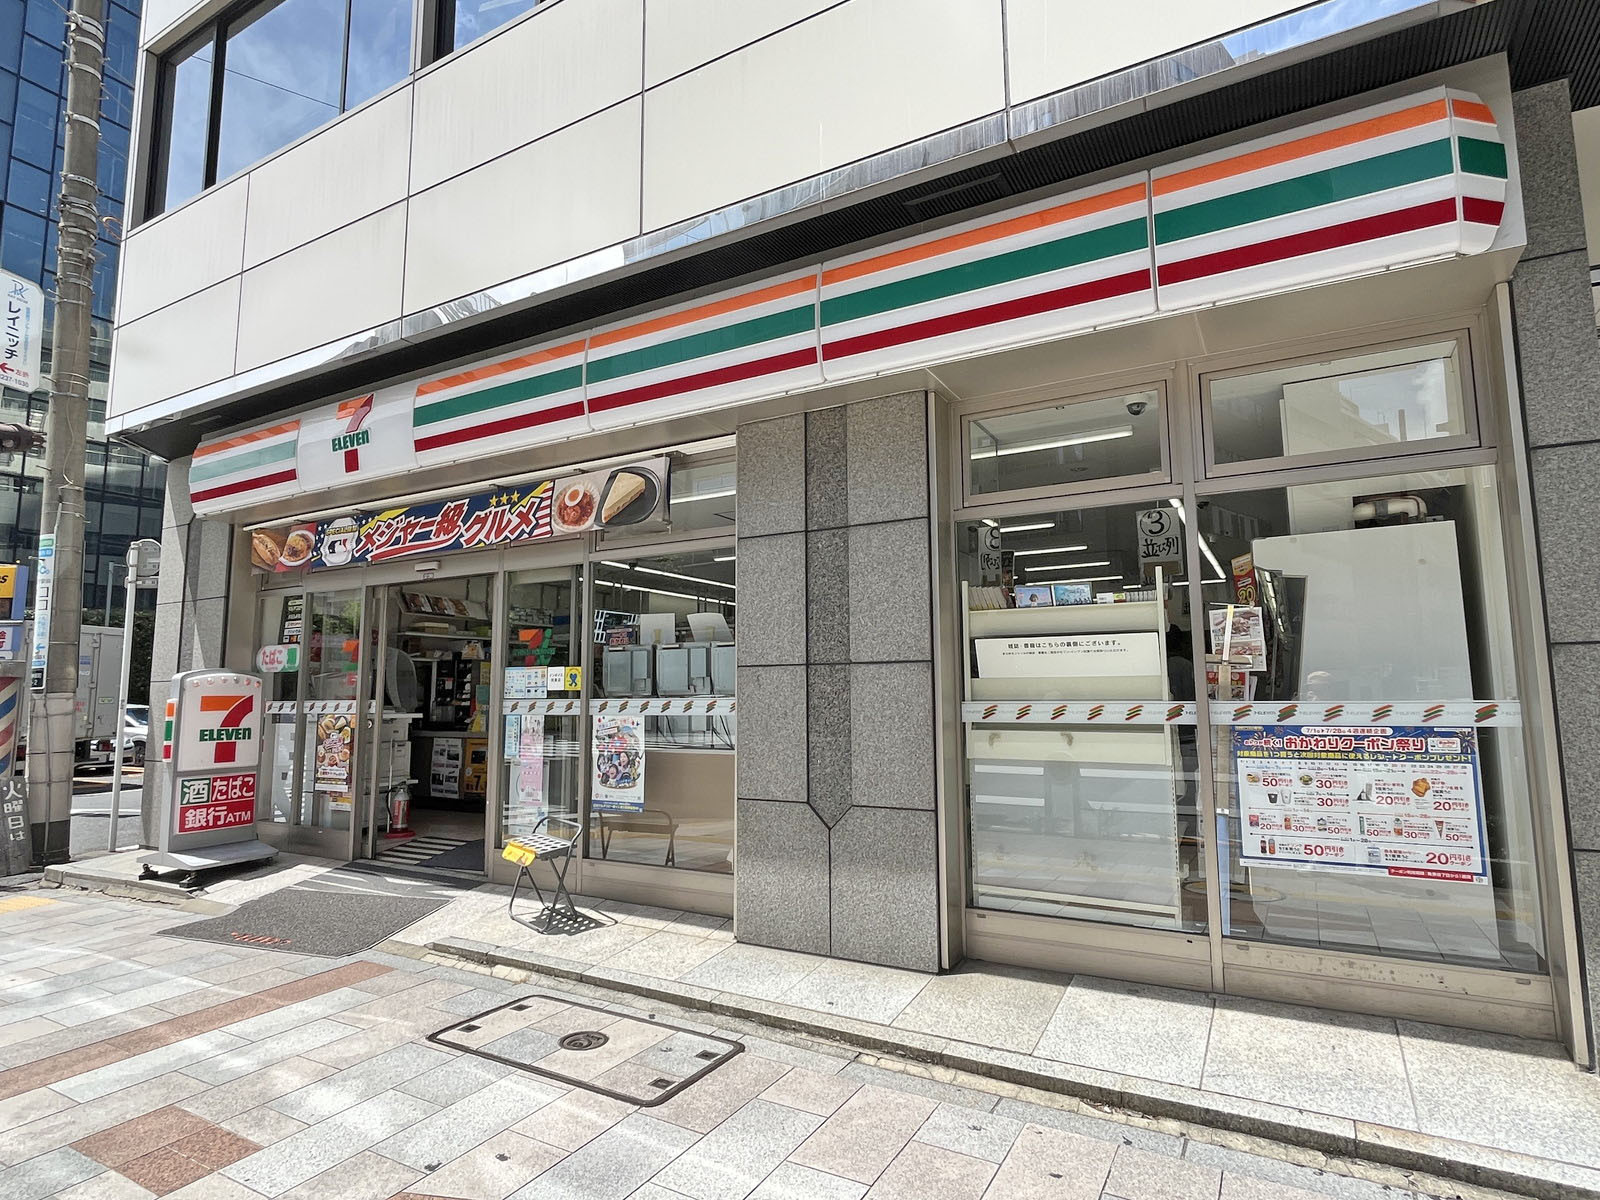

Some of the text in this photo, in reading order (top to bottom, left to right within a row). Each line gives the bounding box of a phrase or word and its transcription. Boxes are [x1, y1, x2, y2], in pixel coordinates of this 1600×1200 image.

[1141, 536, 1179, 558] 並び列
[1285, 735, 1425, 751] おかわりクーポン祭り
[182, 777, 254, 804] 酒 たばこ
[185, 805, 251, 829] 銀行ATM
